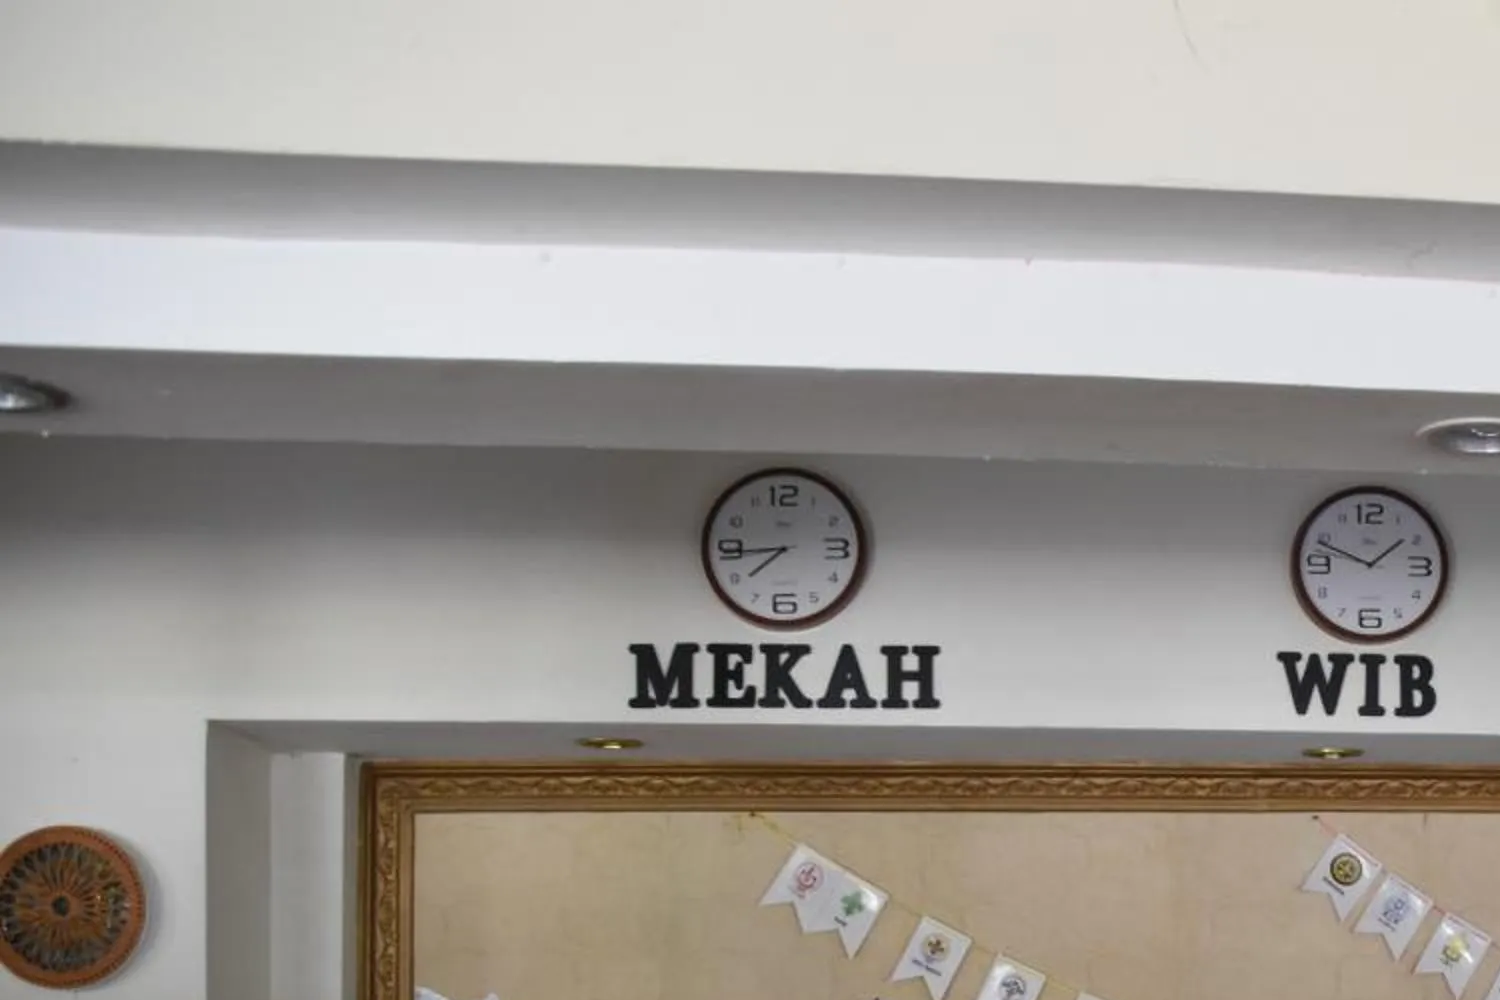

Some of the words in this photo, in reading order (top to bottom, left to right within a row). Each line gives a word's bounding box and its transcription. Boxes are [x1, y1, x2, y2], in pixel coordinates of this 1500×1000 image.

[769, 485, 799, 507] 12
[1356, 503, 1384, 525] 12
[718, 539, 743, 561] 9
[823, 537, 850, 560] 3
[1307, 553, 1331, 575] 9
[1407, 556, 1433, 577] 3
[772, 593, 798, 614] 6
[809, 592, 819, 604] 5
[1358, 608, 1383, 629] 6
[628, 643, 941, 709] MEKAH
[1277, 651, 1437, 717] WIB
